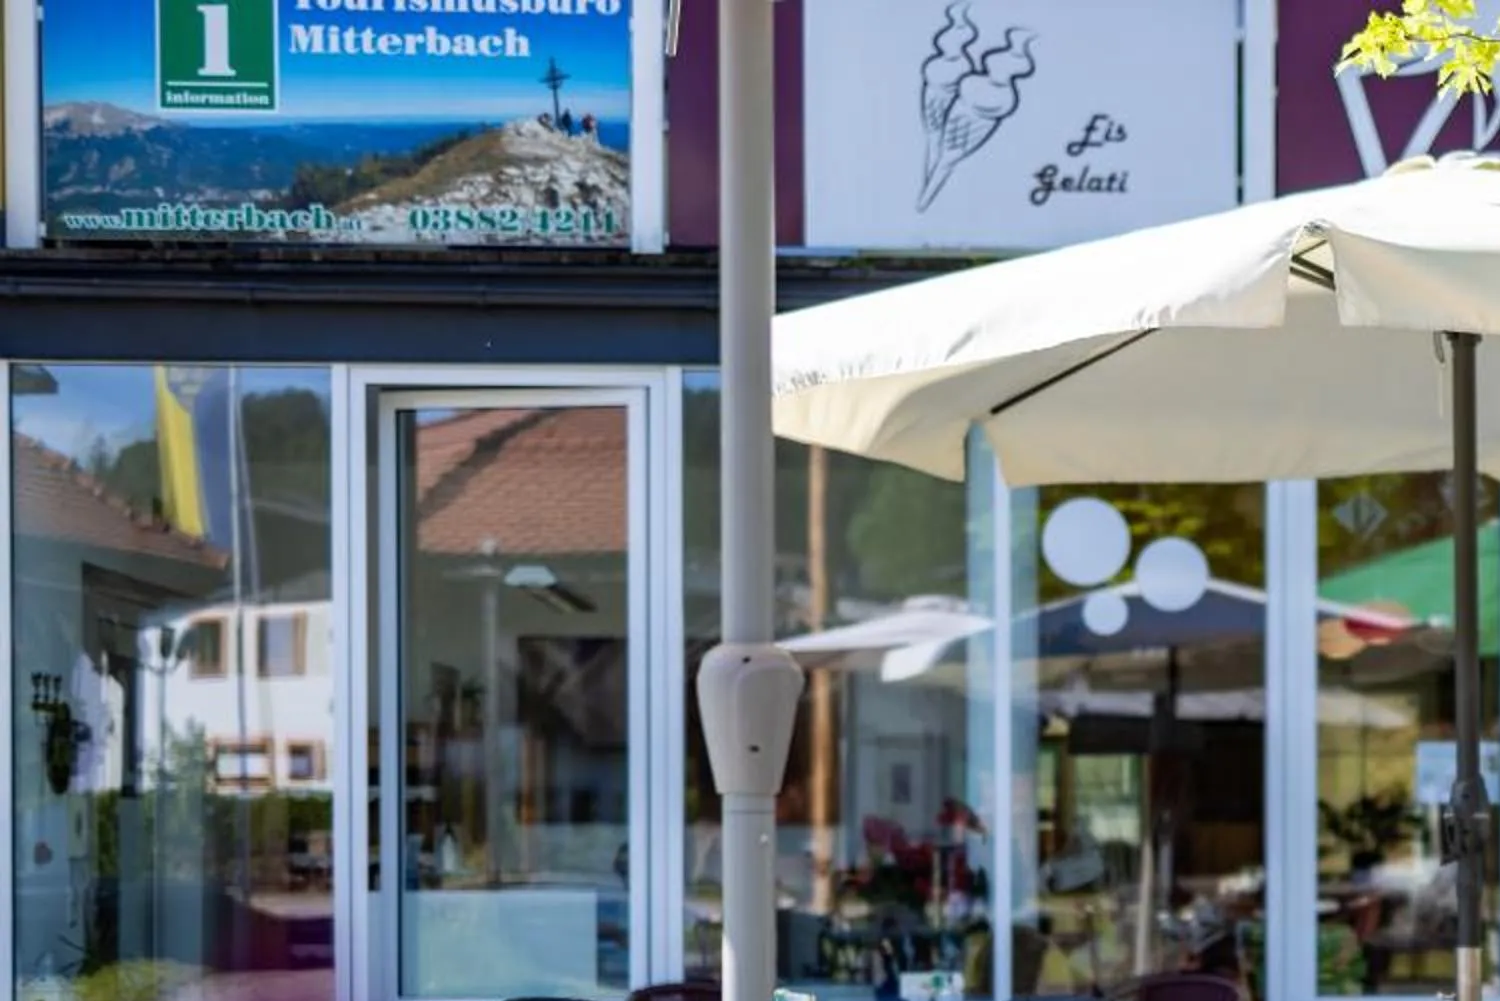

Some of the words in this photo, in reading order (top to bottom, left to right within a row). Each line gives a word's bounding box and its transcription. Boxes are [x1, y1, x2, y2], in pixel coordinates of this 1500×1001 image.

[289, 24, 531, 57] Mitterbach
[165, 90, 269, 105] information
[1066, 114, 1128, 157] Eis
[1029, 163, 1130, 206] Gelati
[408, 207, 519, 233] 03882
